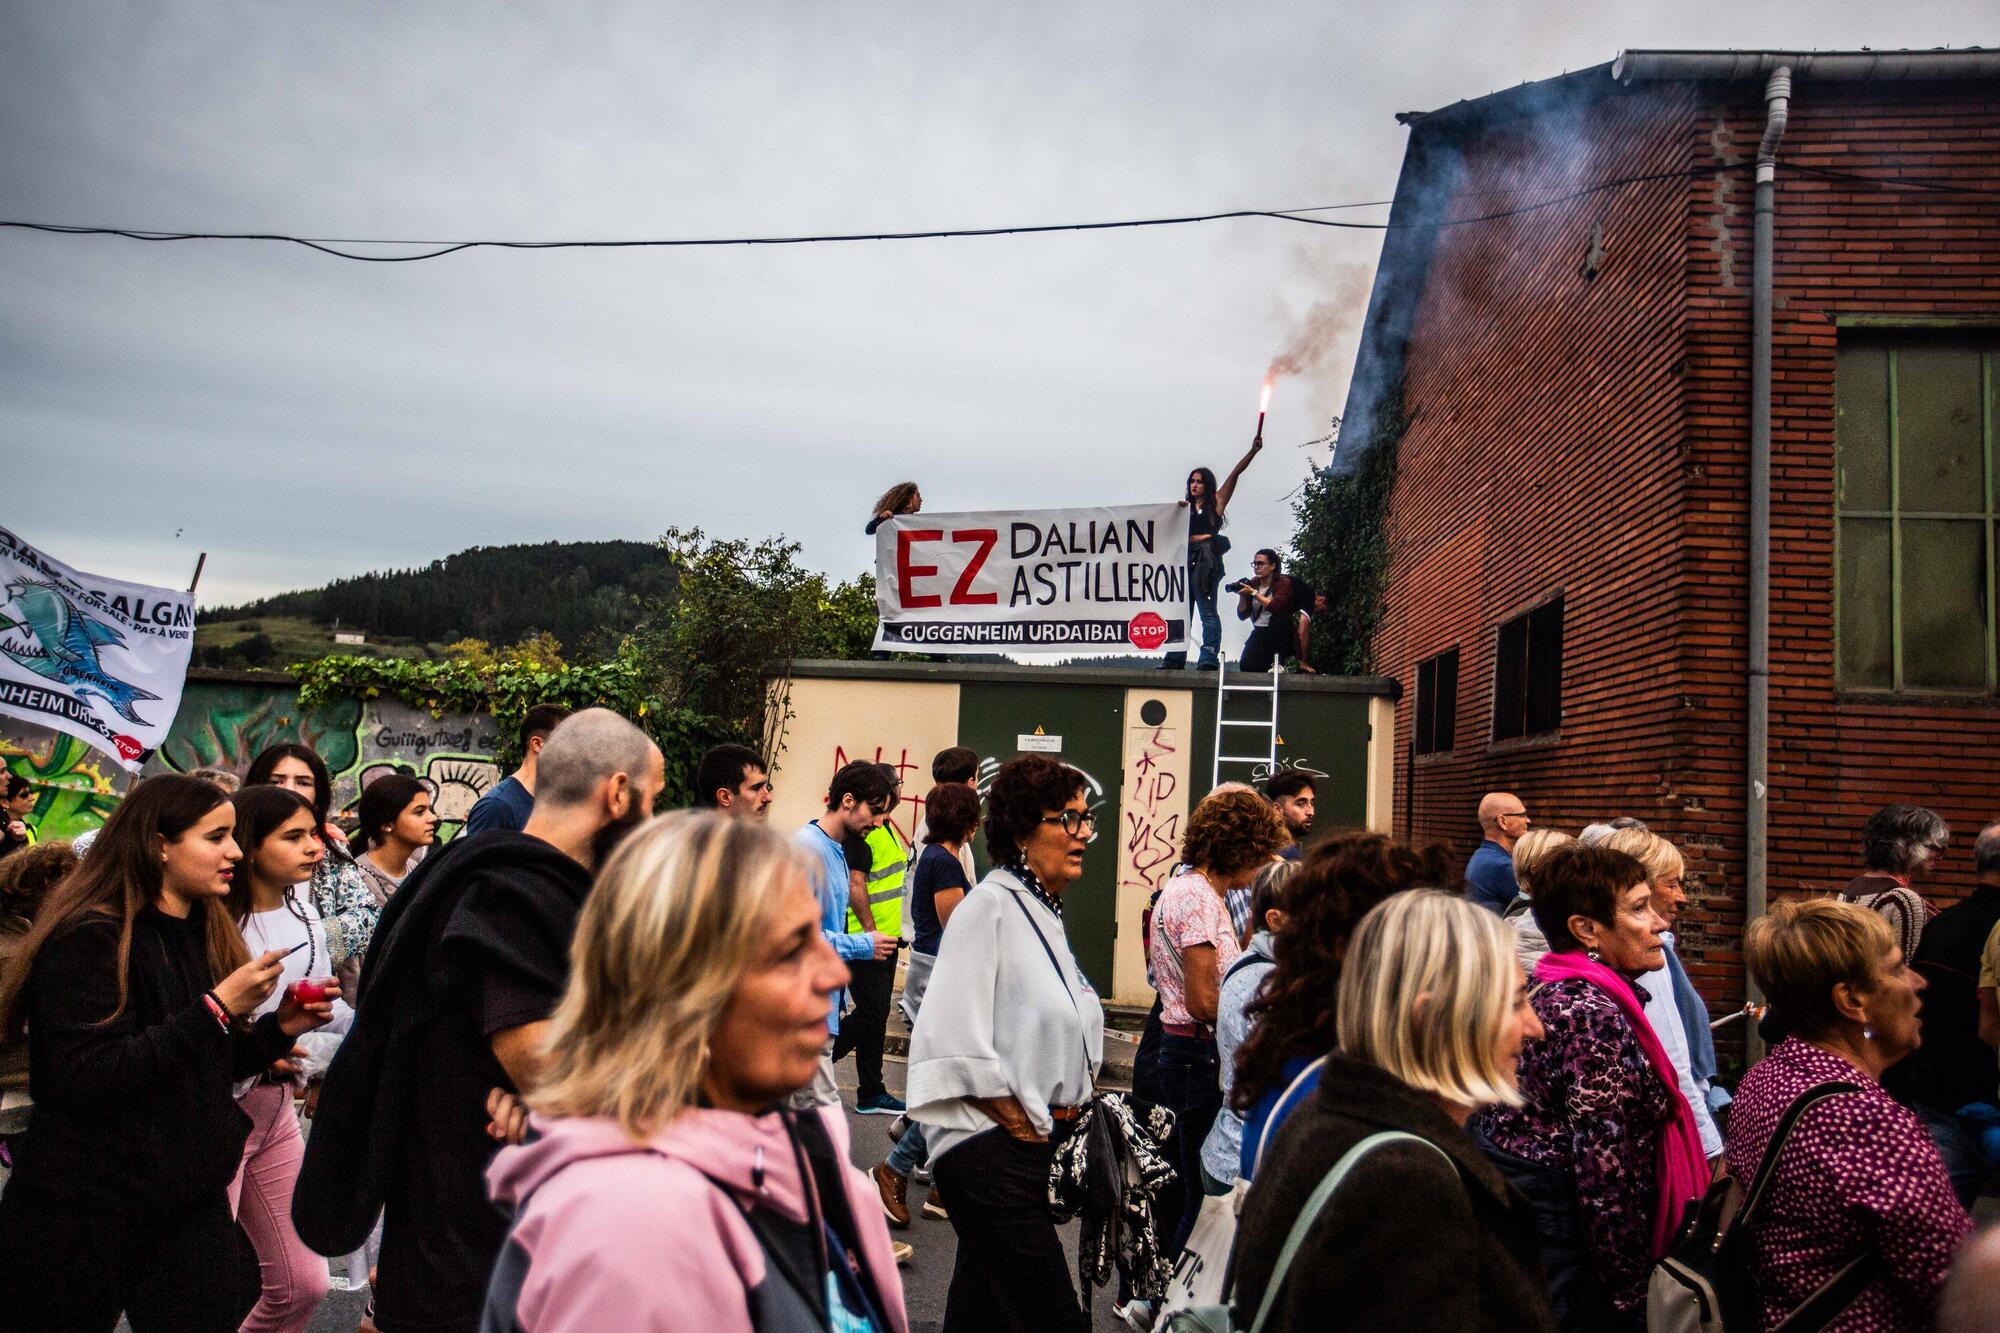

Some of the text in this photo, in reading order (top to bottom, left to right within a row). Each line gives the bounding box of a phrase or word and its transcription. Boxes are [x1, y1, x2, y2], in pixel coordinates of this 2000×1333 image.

[1011, 519, 1155, 559] DALIAN
[896, 528, 998, 609] EZ
[1009, 561, 1185, 608] ASTILLERON
[78, 593, 101, 609] FOR
[102, 604, 128, 626] SALE
[133, 623, 156, 635] PAS
[900, 623, 1122, 642] GUGGENHEIM URDAIBAI
[1132, 625, 1165, 636] STOP
